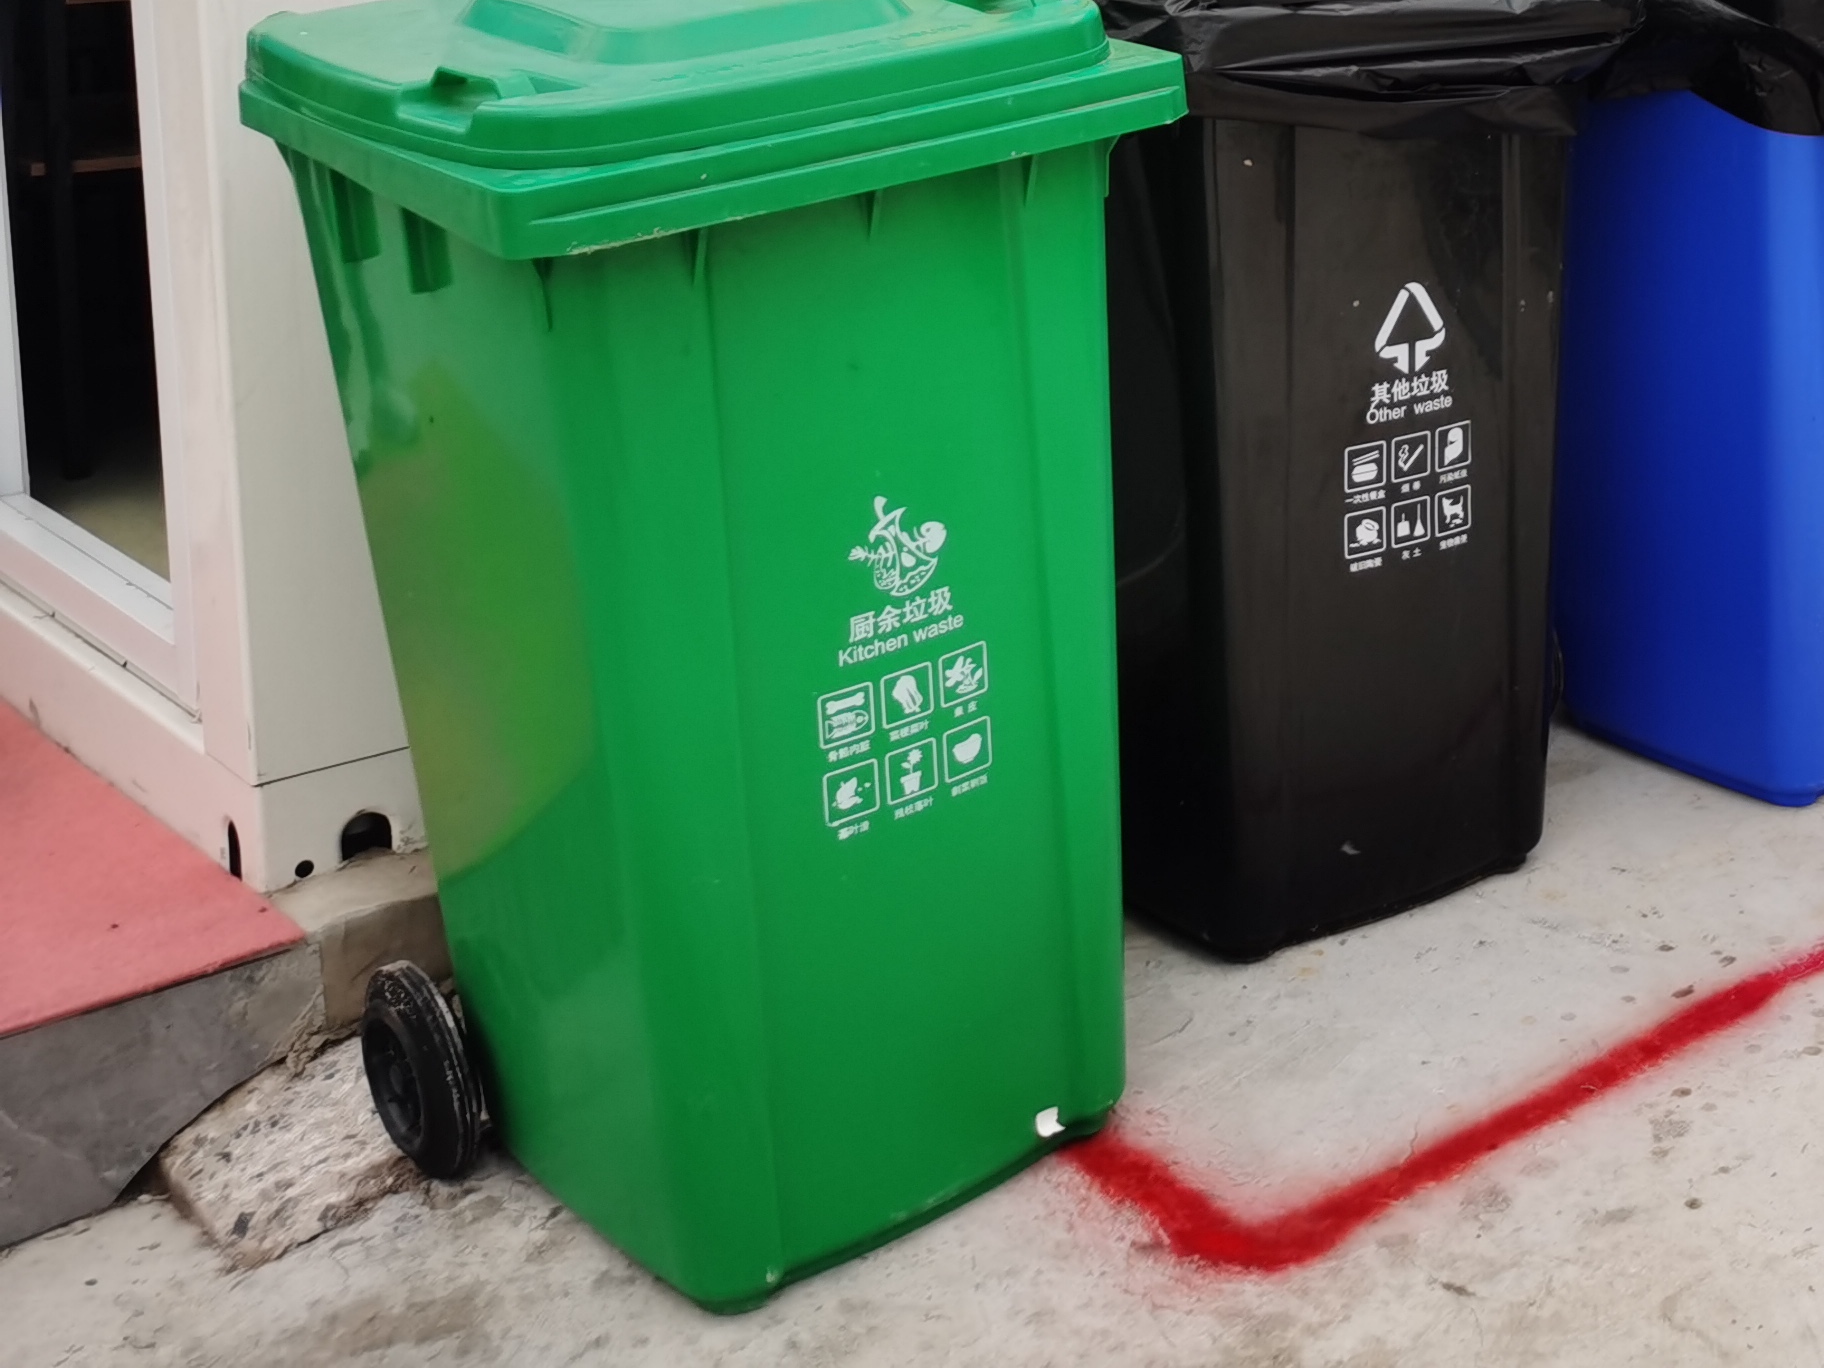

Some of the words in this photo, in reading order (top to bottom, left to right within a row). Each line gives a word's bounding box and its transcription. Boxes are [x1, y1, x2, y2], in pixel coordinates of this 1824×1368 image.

[1366, 402, 1405, 425] Other
[1414, 394, 1453, 416] waste
[1370, 369, 1450, 405] 其他垃圾
[849, 586, 953, 643] 厨余垃圾
[838, 632, 908, 667] Kitchen
[913, 613, 965, 643] waste
